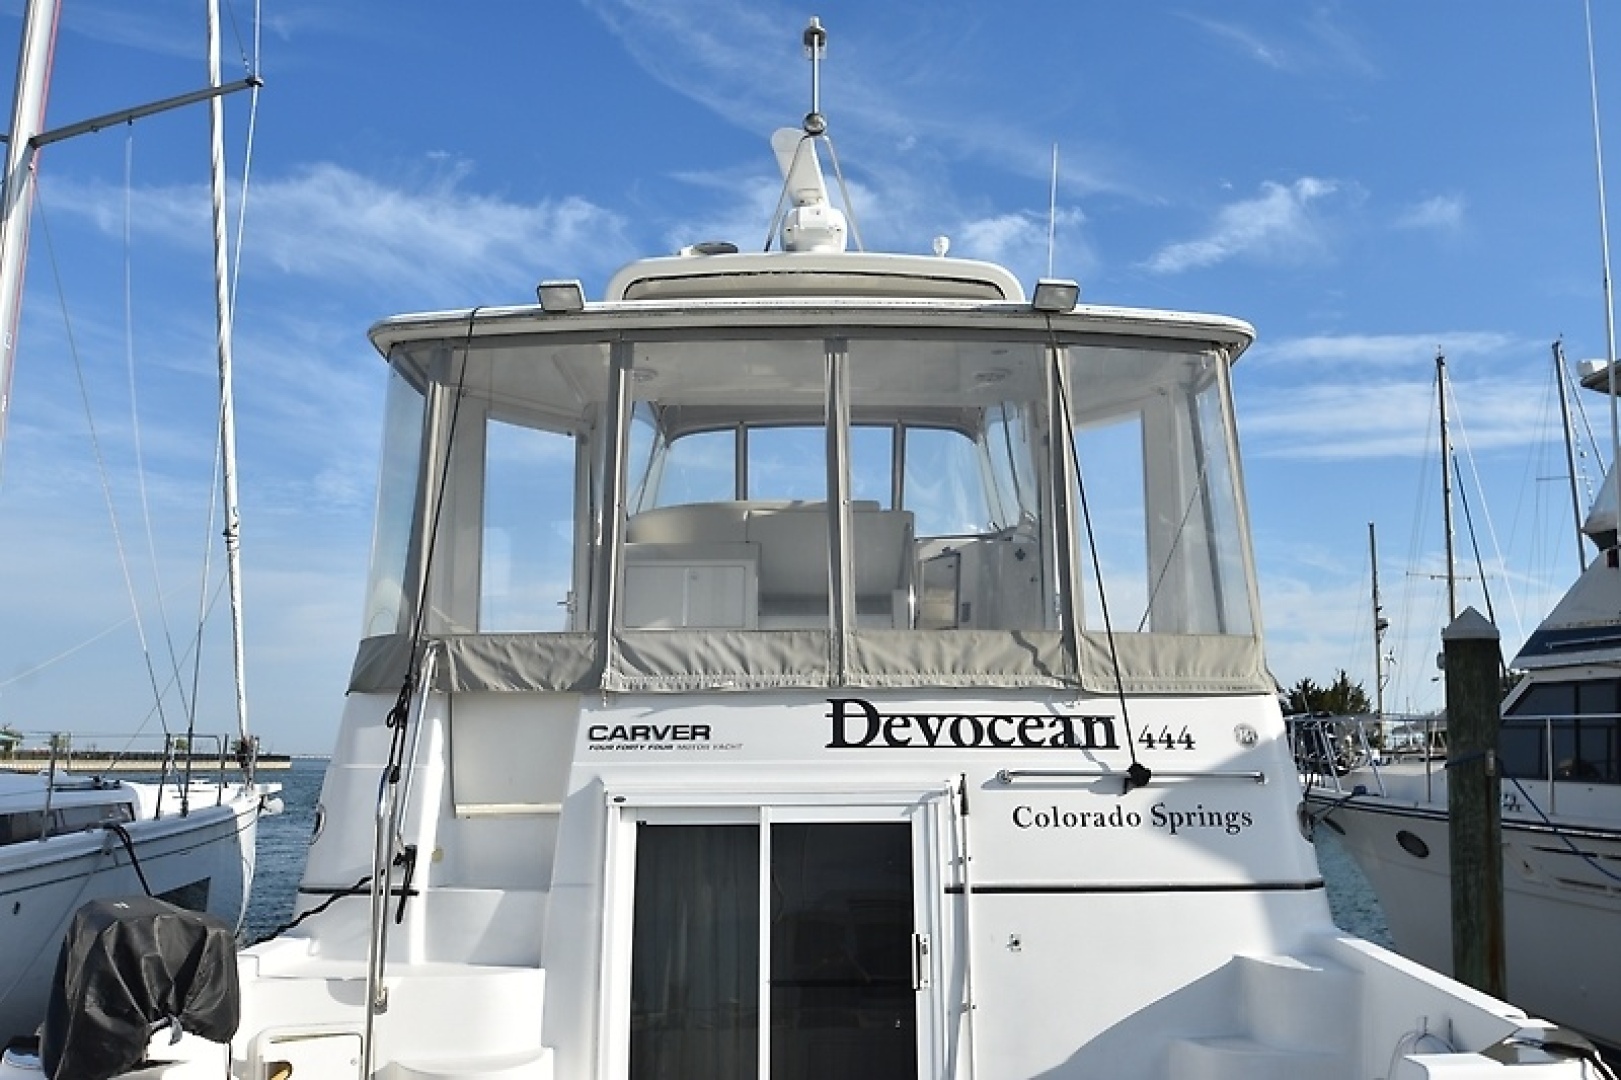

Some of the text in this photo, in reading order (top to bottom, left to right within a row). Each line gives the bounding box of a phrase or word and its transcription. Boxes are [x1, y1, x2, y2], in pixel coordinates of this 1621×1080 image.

[589, 724, 711, 741] CARVER
[825, 698, 1196, 750] Devocean 444
[1012, 802, 1253, 835] Colorado Springs
